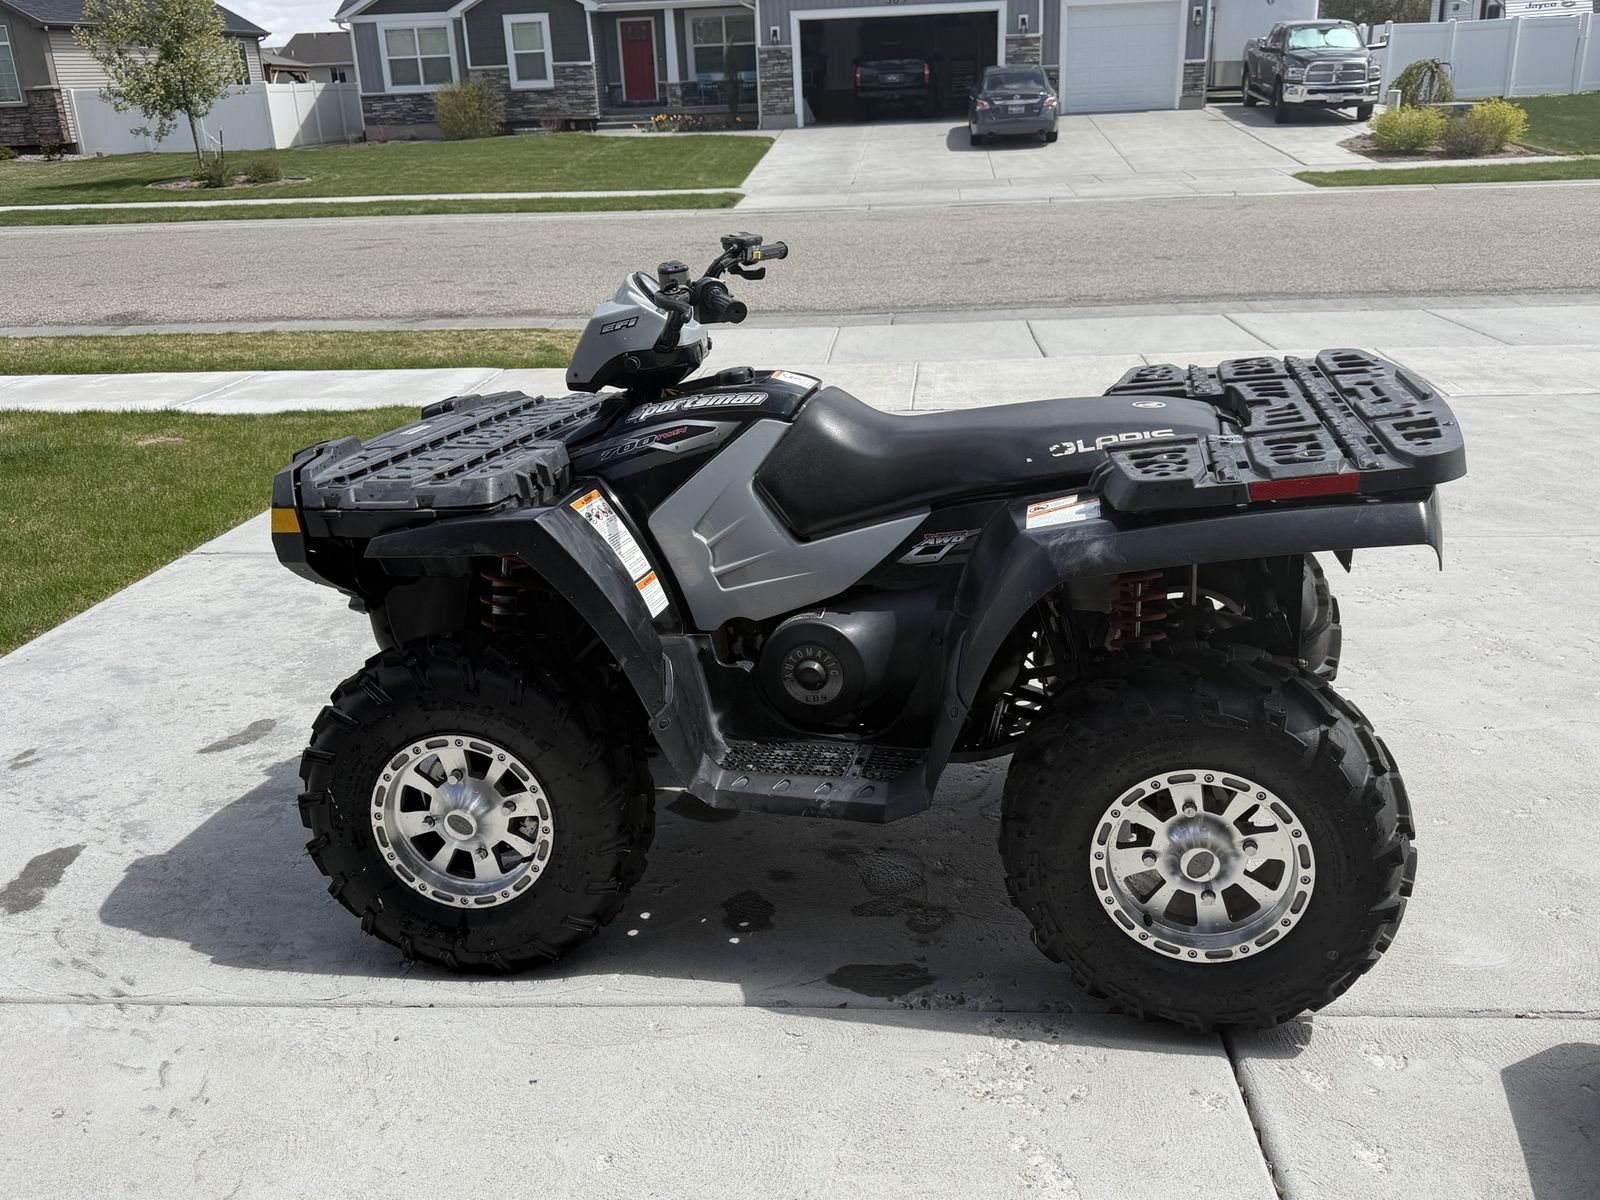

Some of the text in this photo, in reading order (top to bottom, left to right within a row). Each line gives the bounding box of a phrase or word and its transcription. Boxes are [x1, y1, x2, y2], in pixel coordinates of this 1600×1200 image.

[600, 316, 639, 334] EFI
[626, 392, 768, 424] Sportsman
[600, 434, 657, 461] 700
[917, 532, 967, 547] AWD
[783, 647, 839, 681] AUTOMATIC
